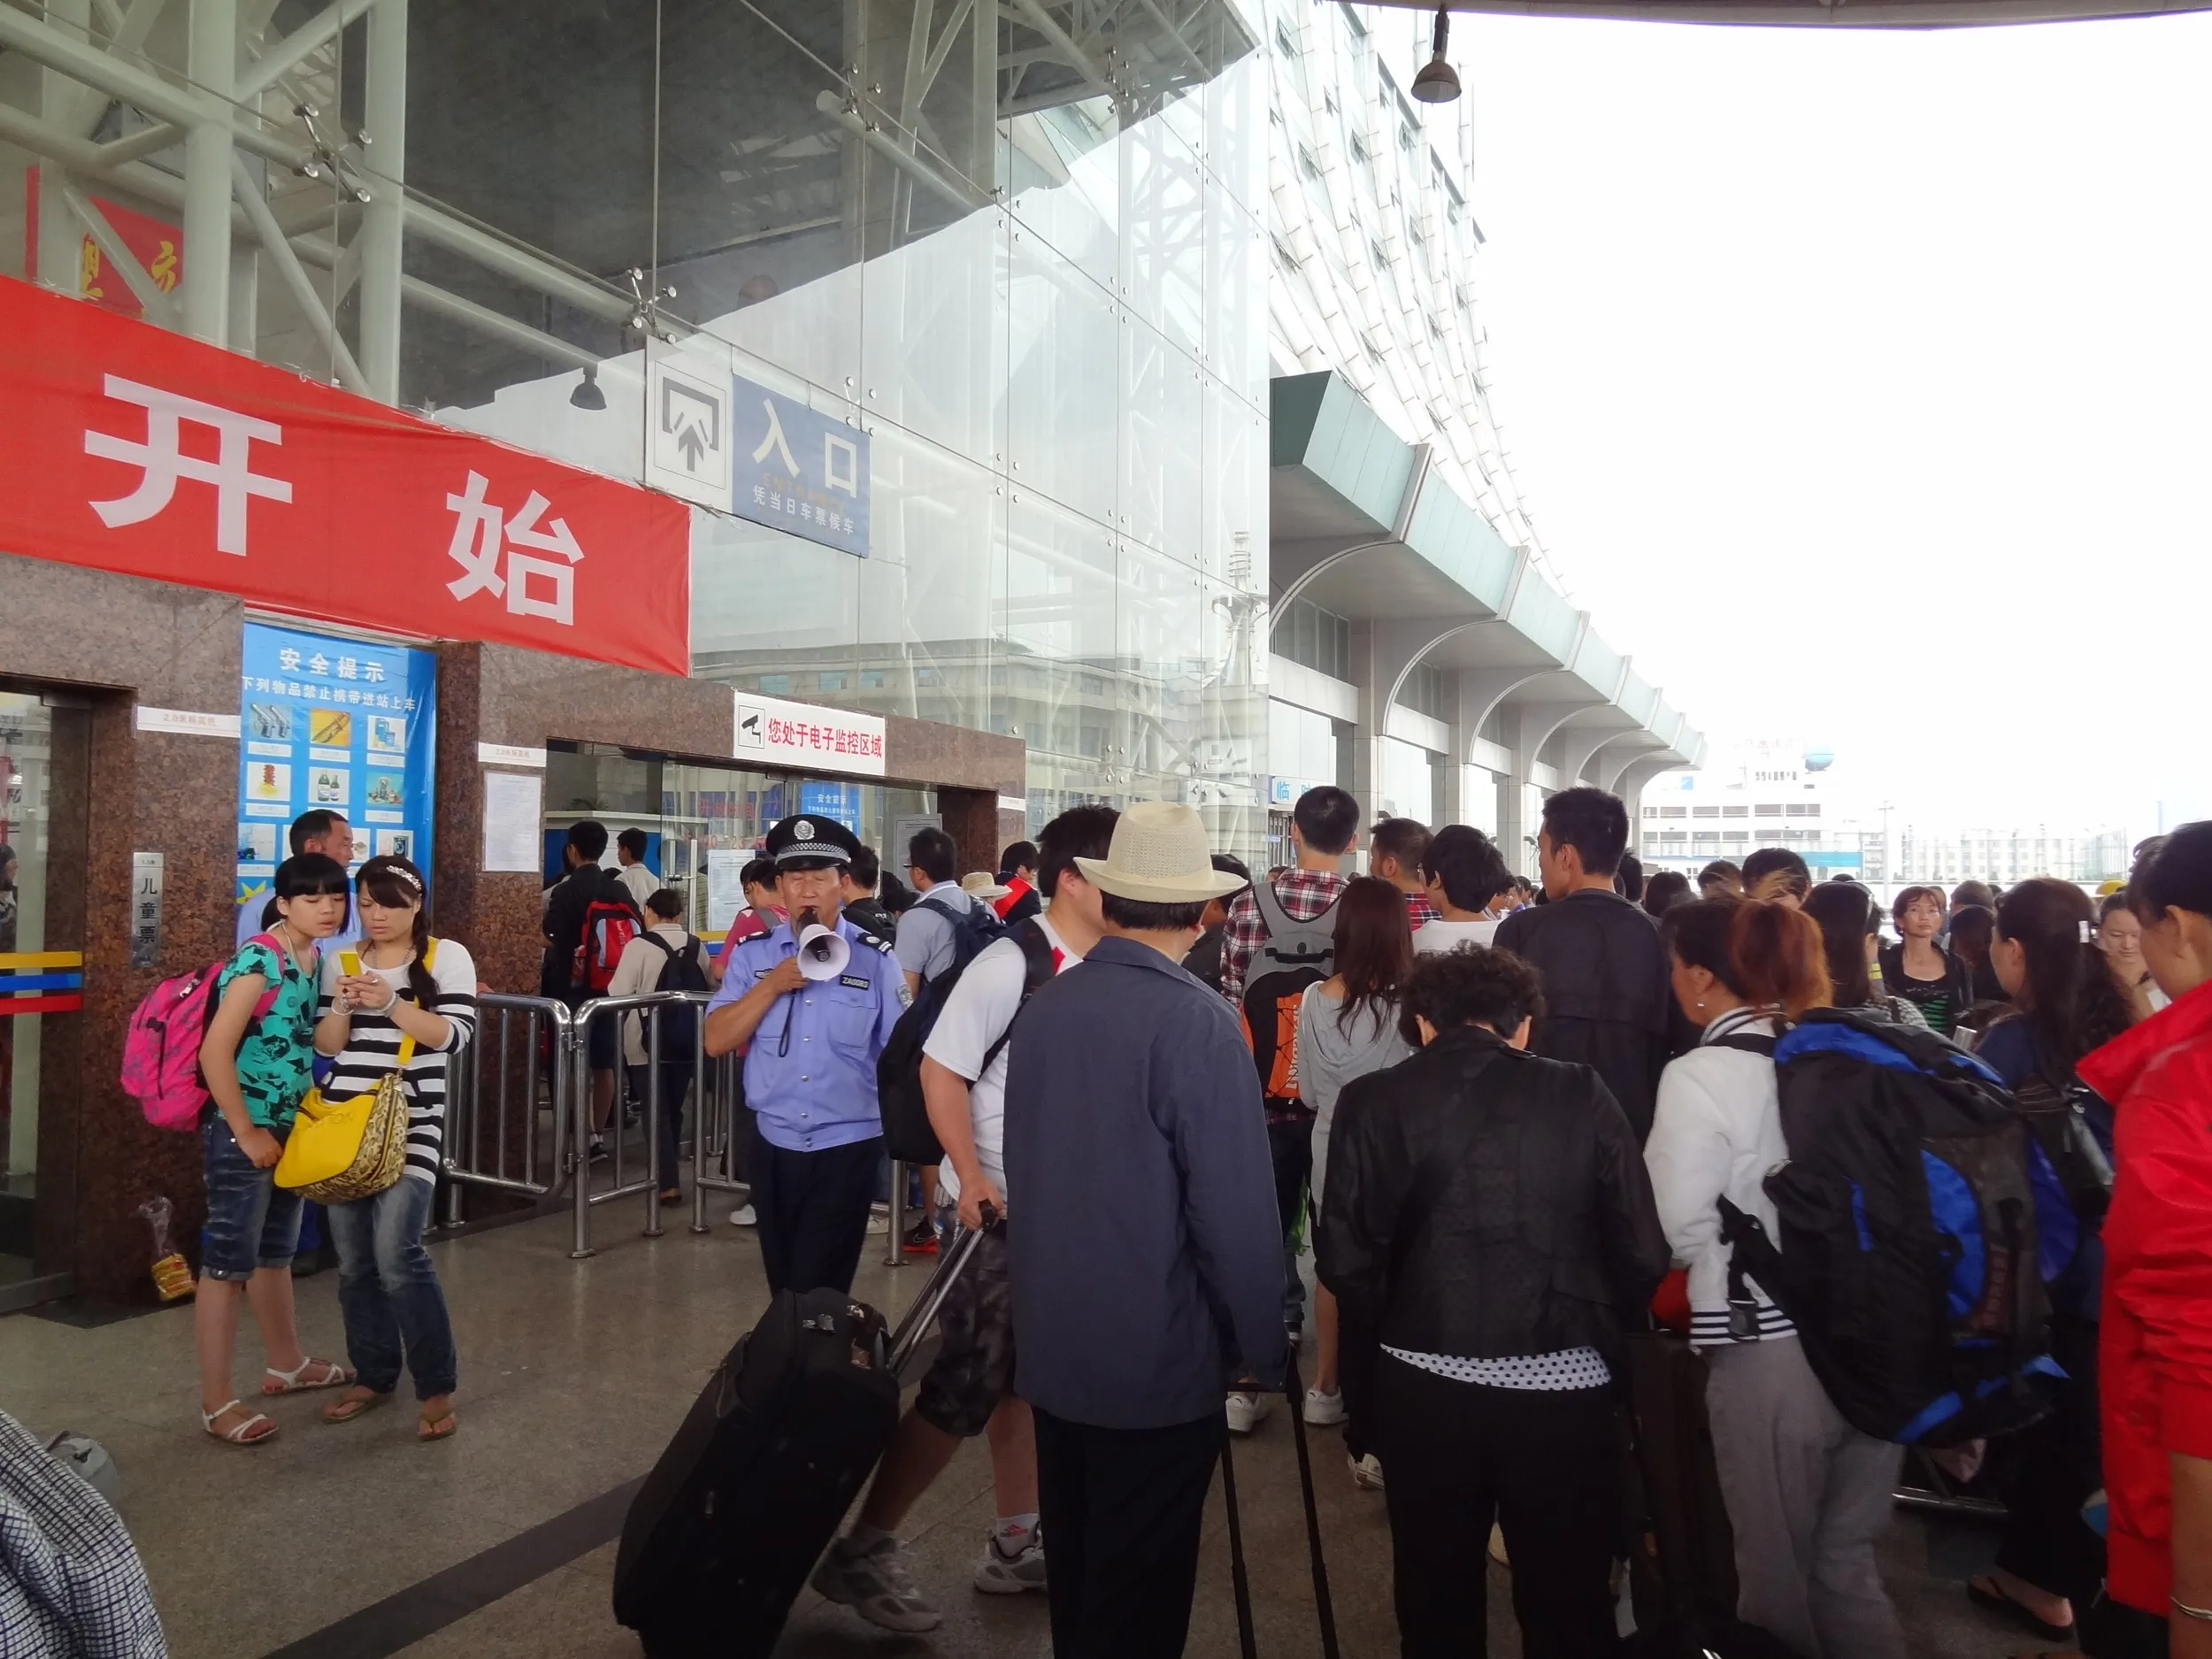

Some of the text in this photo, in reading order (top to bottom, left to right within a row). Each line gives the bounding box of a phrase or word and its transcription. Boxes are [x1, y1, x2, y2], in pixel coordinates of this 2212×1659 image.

[752, 398, 857, 499] 入口
[84, 373, 585, 626] 开始
[753, 485, 854, 535] 凭当日车票候车
[280, 648, 385, 683] 安全提示
[242, 675, 416, 711] 下列物品禁止携带进站上车
[768, 718, 882, 758] 您处于电子监控区域
[139, 878, 158, 943] 儿童票
